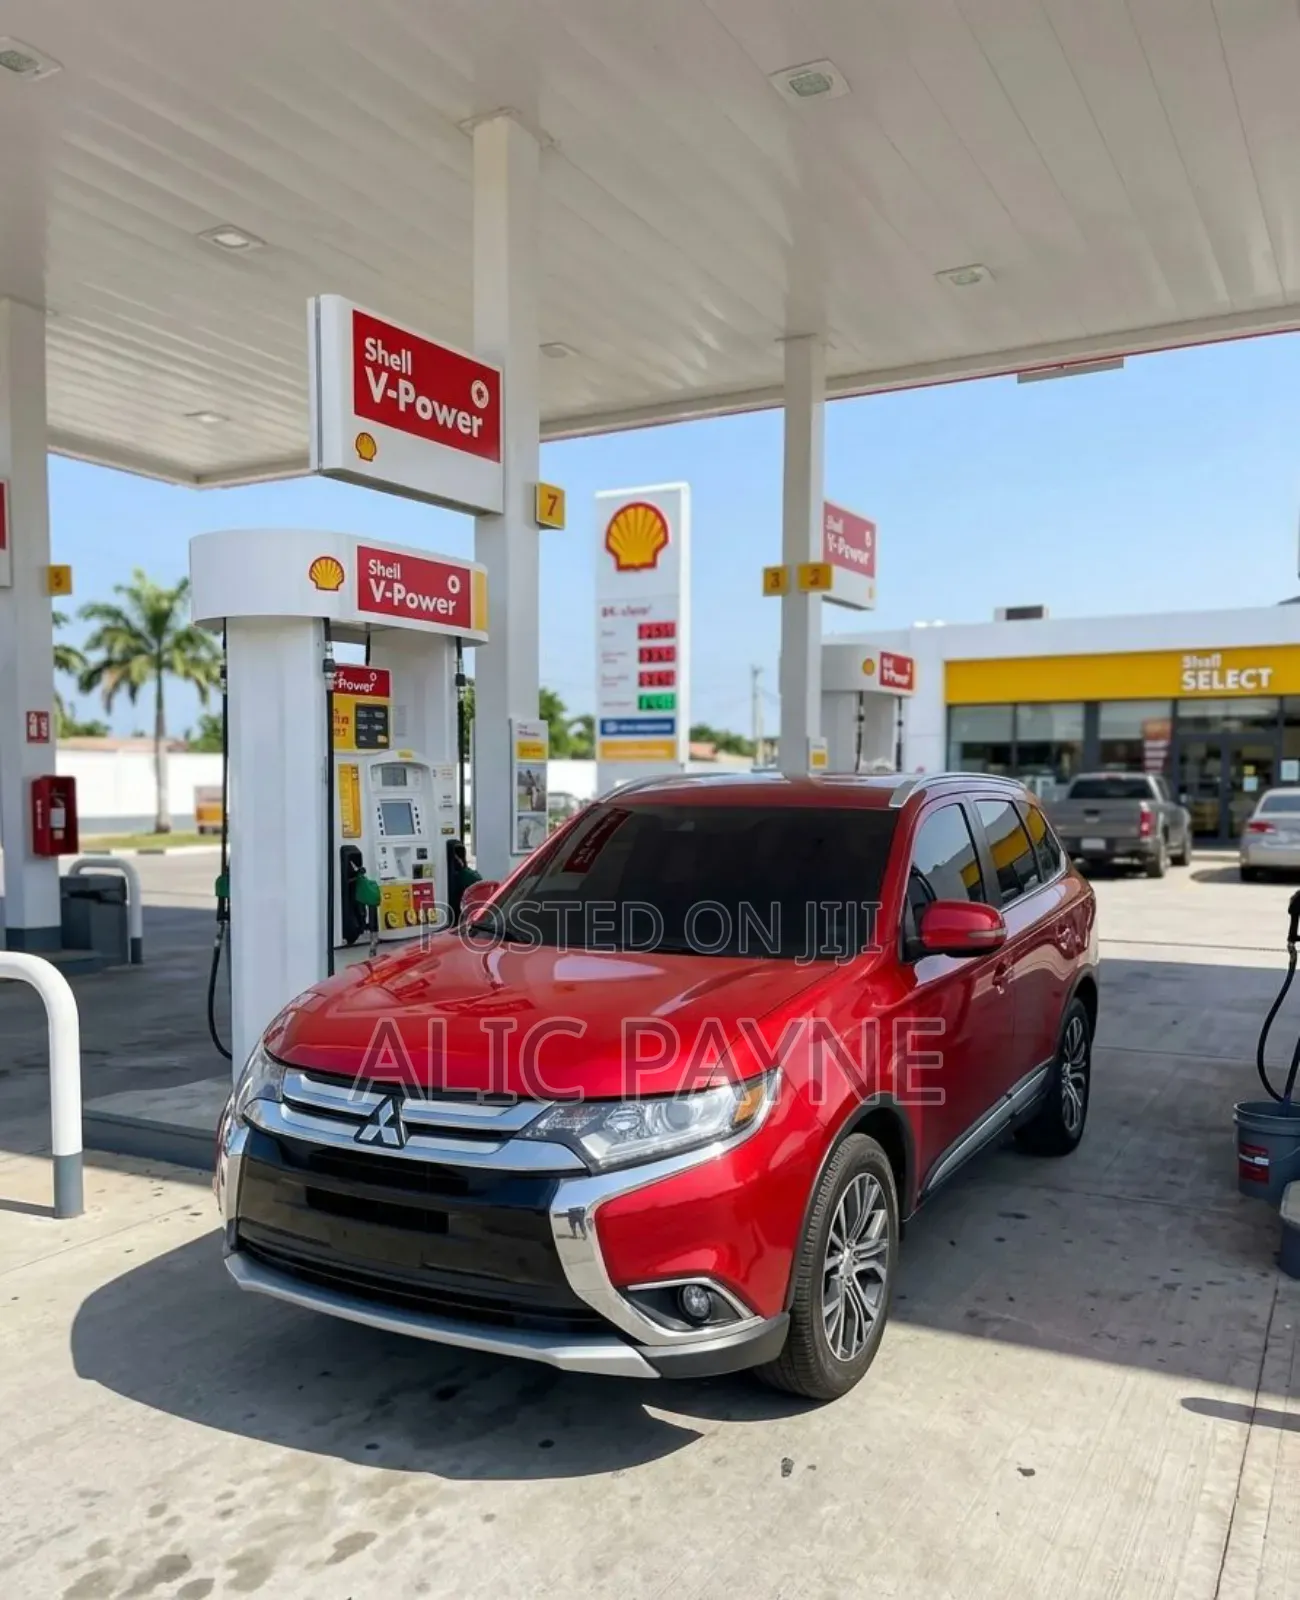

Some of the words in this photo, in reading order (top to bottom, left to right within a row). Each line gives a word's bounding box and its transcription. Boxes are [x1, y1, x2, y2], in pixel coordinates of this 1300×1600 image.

[364, 337, 412, 376] Shell
[364, 366, 483, 438] V-Power
[547, 494, 560, 516] 7
[369, 578, 457, 616] V-Power
[1181, 667, 1273, 691] SELECT
